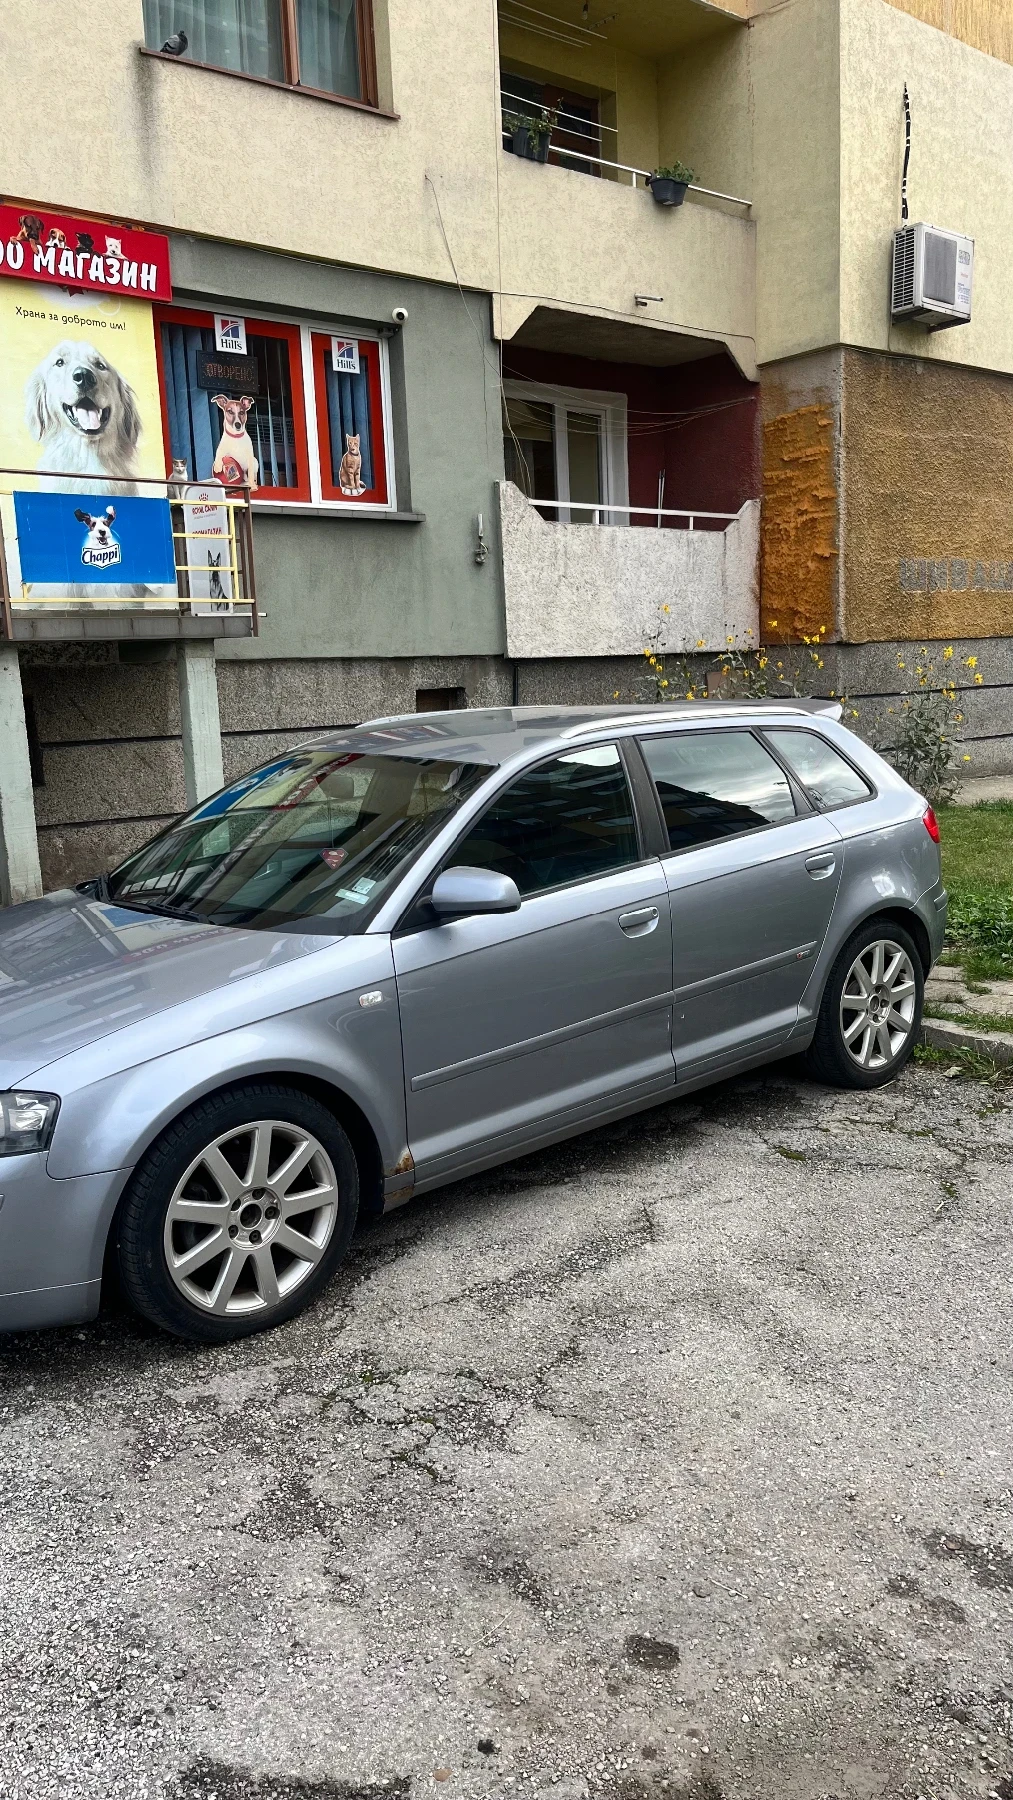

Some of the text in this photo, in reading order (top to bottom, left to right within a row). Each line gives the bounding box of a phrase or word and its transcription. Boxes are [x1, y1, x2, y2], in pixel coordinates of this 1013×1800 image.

[0, 240, 158, 293] О МАГАЗИН
[15, 306, 126, 331] Храна за доброто им!
[220, 338, 243, 351] Hill's
[336, 359, 356, 370] Hill's
[82, 547, 118, 564] Chappi
